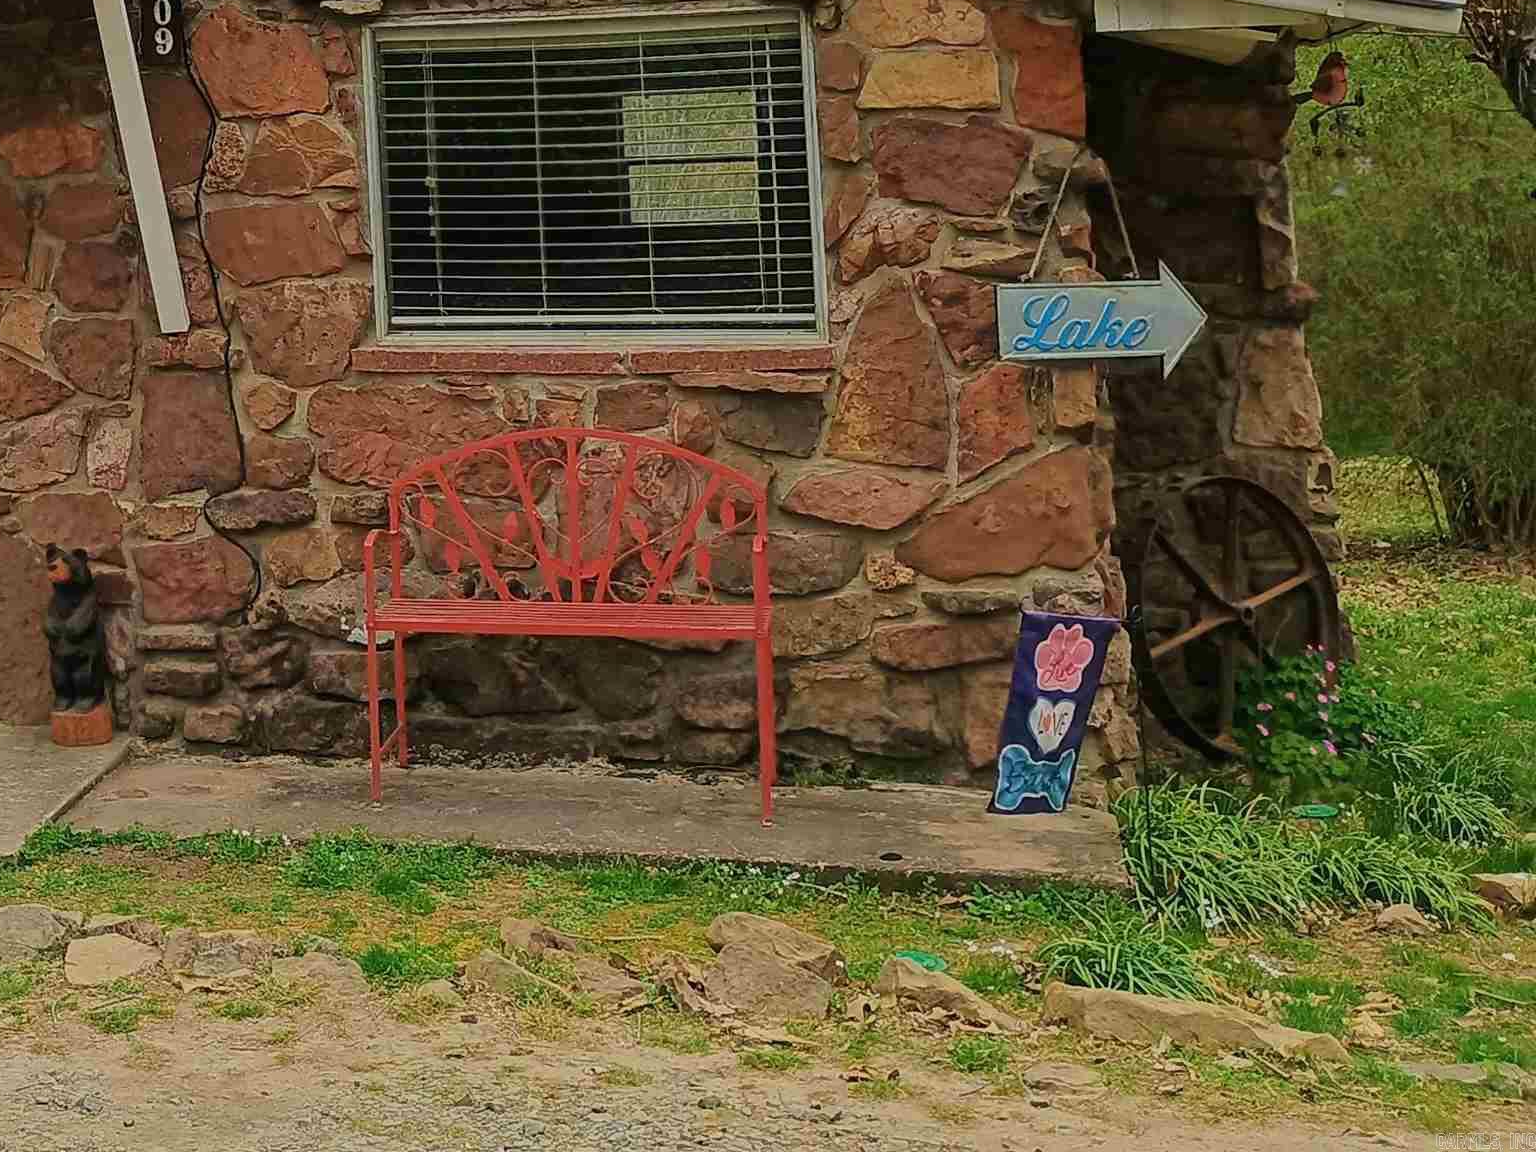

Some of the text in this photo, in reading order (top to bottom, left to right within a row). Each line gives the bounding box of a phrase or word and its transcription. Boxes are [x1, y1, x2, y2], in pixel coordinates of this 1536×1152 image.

[1012, 291, 1153, 353] Lake
[1040, 650, 1082, 684] Live
[1037, 710, 1070, 737] LOVE
